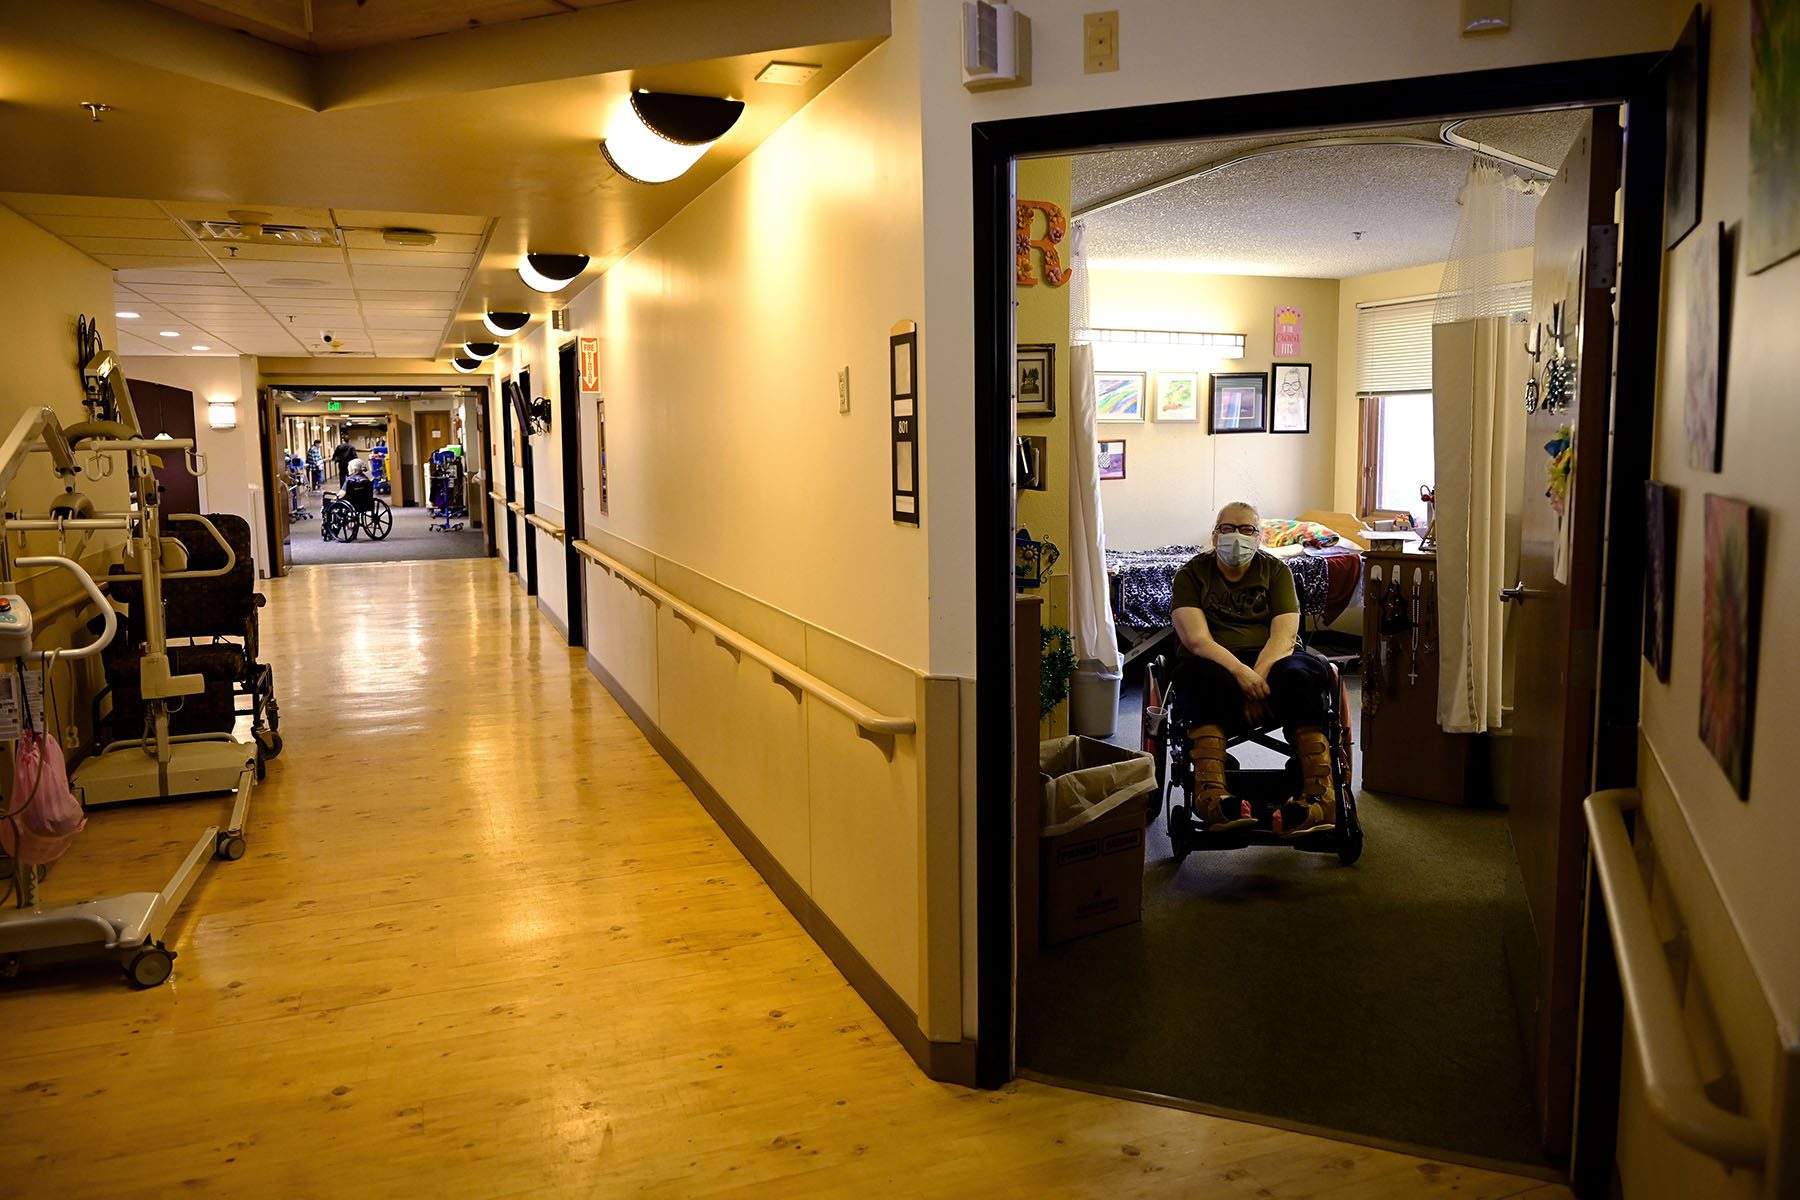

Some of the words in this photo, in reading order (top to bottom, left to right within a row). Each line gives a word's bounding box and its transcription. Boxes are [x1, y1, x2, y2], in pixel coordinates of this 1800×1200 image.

[1016, 200, 1073, 288] R
[584, 343, 595, 351] FIRE
[898, 420, 909, 434] 801
